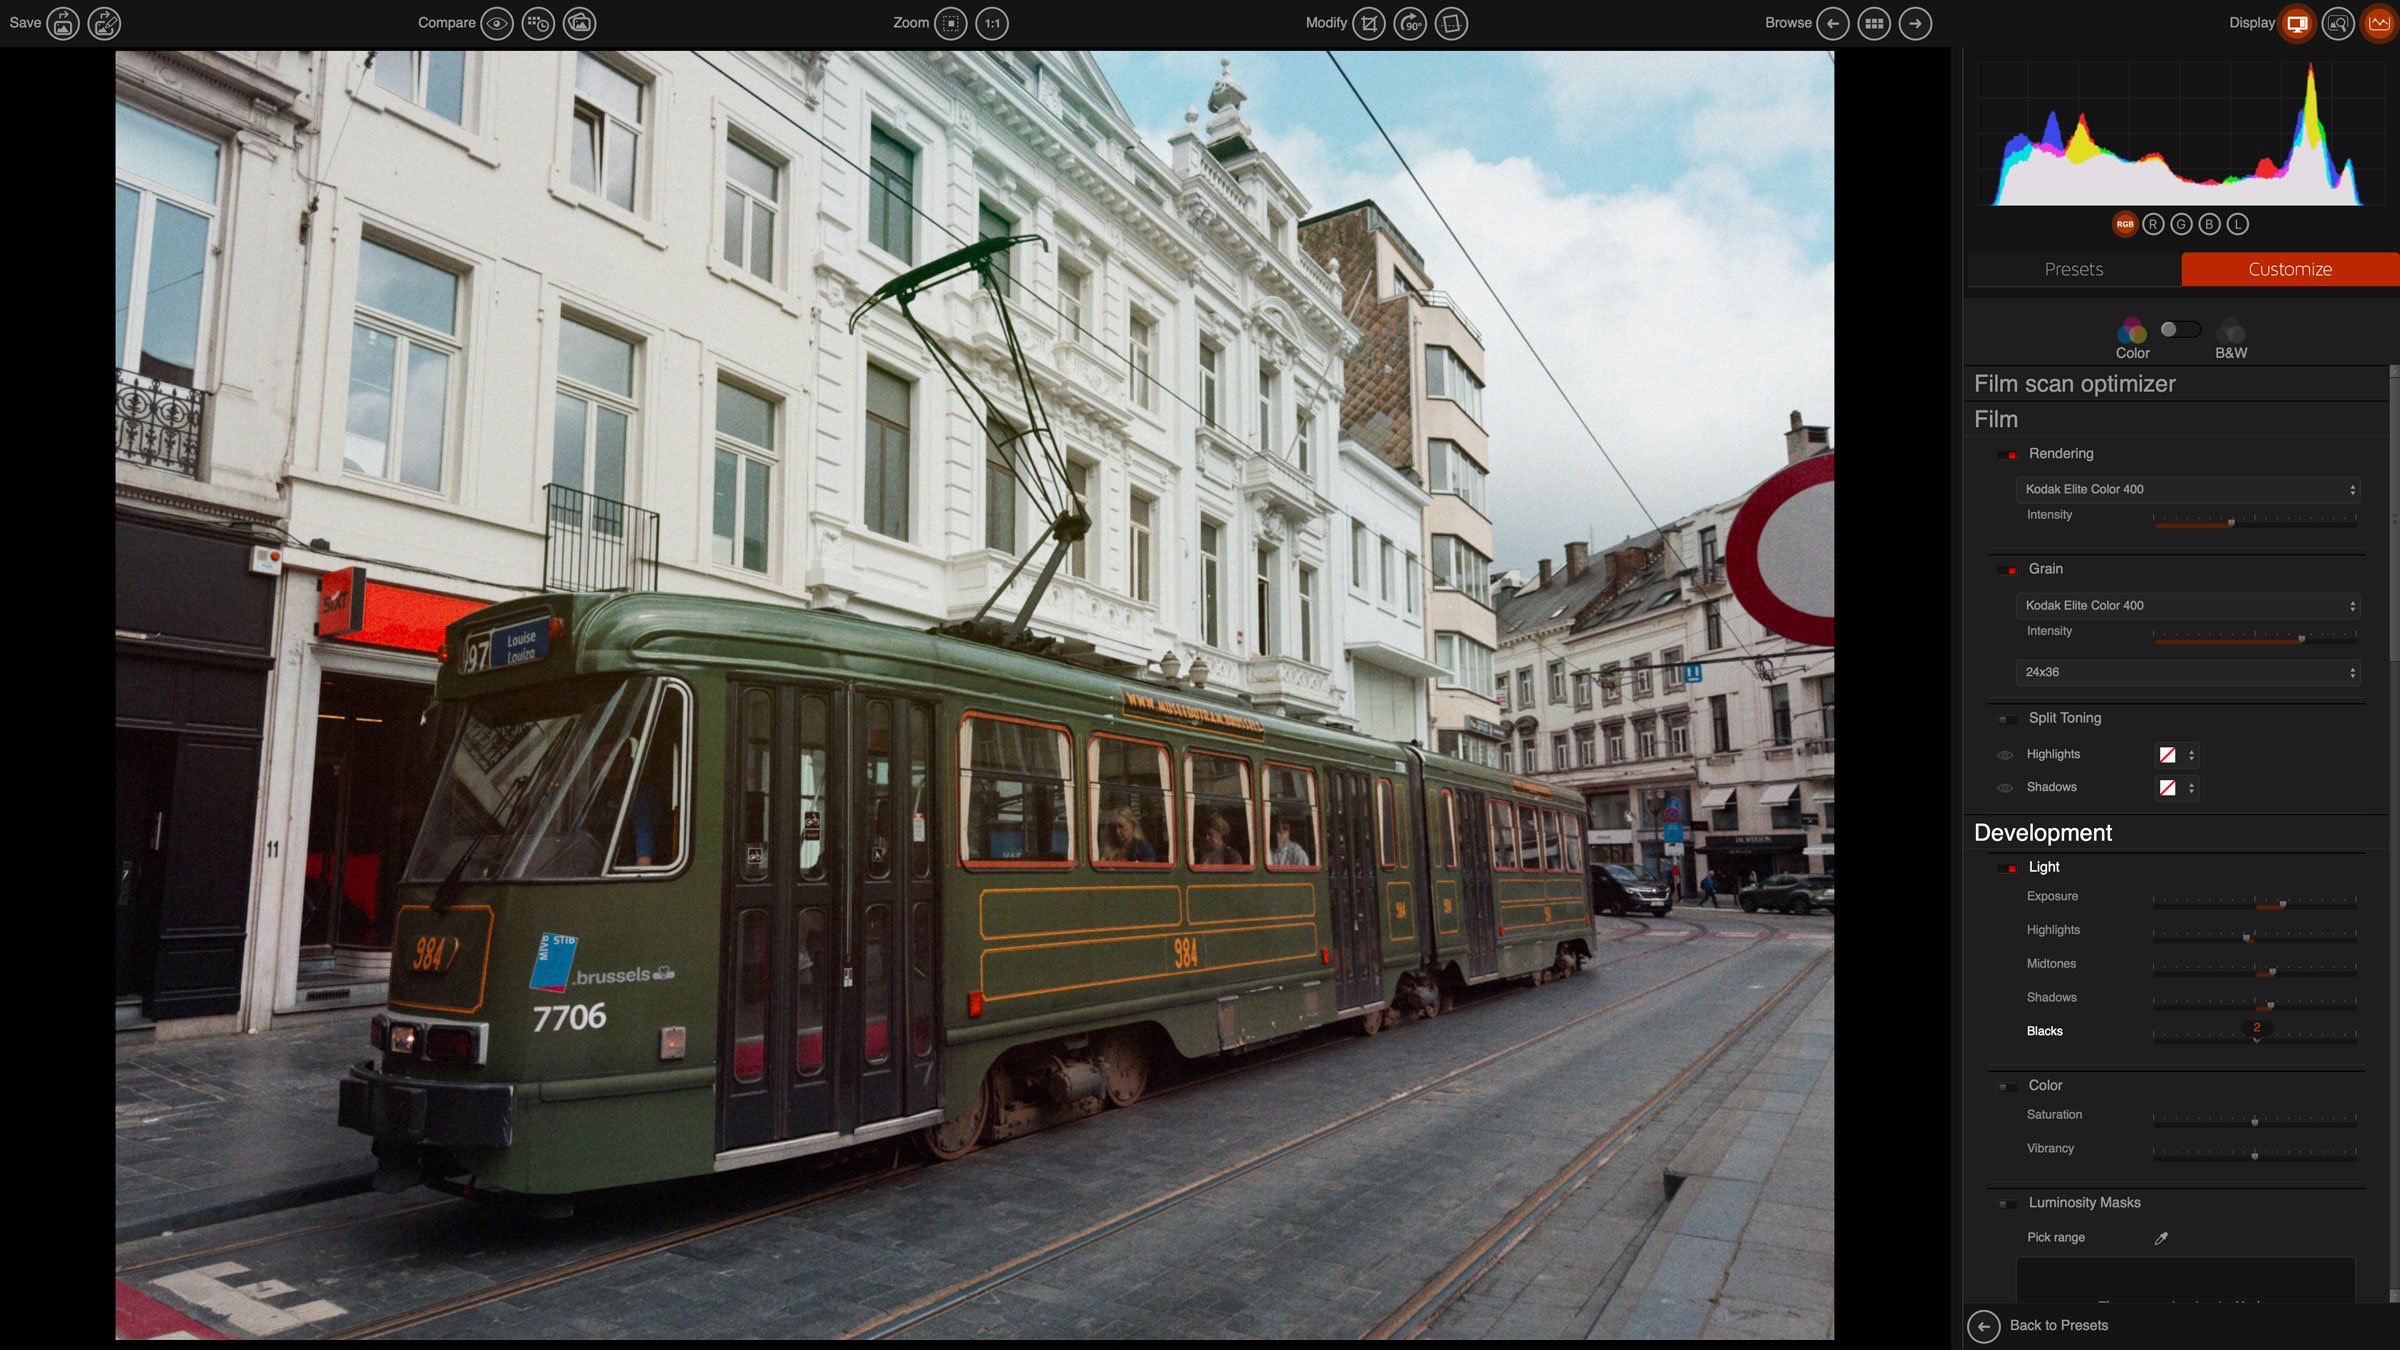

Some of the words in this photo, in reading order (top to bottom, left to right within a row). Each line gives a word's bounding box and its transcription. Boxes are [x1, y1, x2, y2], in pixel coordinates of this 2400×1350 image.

[9, 16, 42, 29] Save
[418, 16, 477, 32] Compare
[893, 16, 930, 29] Zoom
[984, 18, 1000, 29] 1:1
[1306, 16, 1348, 32] Modify
[1406, 22, 1422, 30] 90°
[1765, 16, 1813, 29] Browse
[2229, 16, 2276, 31] Display
[2116, 220, 2134, 228] RGB
[2149, 219, 2157, 230] R
[2176, 219, 2186, 230] G
[2205, 219, 2214, 230] B
[2235, 219, 2242, 230] L
[2045, 262, 2104, 277] Presets
[2249, 261, 2333, 277] Customize
[2116, 346, 2151, 359] Color
[2215, 346, 2249, 359] B&W
[1975, 373, 2018, 393] Film
[2025, 378, 2074, 393] scan
[2080, 373, 2177, 398] optimizer
[1975, 409, 2018, 428] Film
[2029, 447, 2094, 462] Rendering
[2026, 483, 2062, 495] Kodak
[2064, 483, 2088, 495] Elite
[2090, 483, 2121, 495] Color
[2122, 483, 2145, 495] 400
[2027, 508, 2073, 522] Intensity
[2028, 562, 2064, 575] Grain
[2026, 599, 2062, 611] Kodak
[2064, 599, 2088, 611] Elite
[2090, 599, 2121, 611] Color
[2122, 600, 2145, 611] 400
[2027, 625, 2073, 639] Intensity
[507, 631, 536, 648] Louise
[469, 641, 489, 673] 97
[507, 648, 535, 664] Louiza
[2025, 666, 2060, 678] 24x36
[2029, 711, 2057, 727] Split
[2059, 711, 2102, 727] Toning
[2027, 748, 2081, 762] Highlights
[2026, 781, 2078, 792] Shadows
[1975, 822, 2113, 847] Development
[267, 840, 279, 858] 11
[2029, 860, 2061, 876] Light
[2027, 890, 2079, 904] Exposure
[2027, 924, 2081, 938] Highlights
[553, 935, 576, 945] STIB
[412, 936, 445, 970] 984
[1174, 937, 1198, 968] 984
[2027, 957, 2077, 969] Midtones
[2026, 991, 2078, 1003] Shadows
[533, 1001, 607, 1032] 7706
[2027, 1025, 2064, 1037] Blacks
[2253, 1021, 2261, 1033] 2
[2028, 1078, 2064, 1092] Color
[2026, 1108, 2083, 1120] Saturation
[2026, 1142, 2075, 1156] Vibrancy
[2029, 1196, 2097, 1211] Luminosity
[2100, 1196, 2142, 1209] Masks
[2027, 1231, 2052, 1243] Pick
[2053, 1233, 2086, 1245] range
[2010, 1318, 2042, 1332] Back
[2044, 1319, 2058, 1332] to
[2061, 1318, 2109, 1332] Presets
